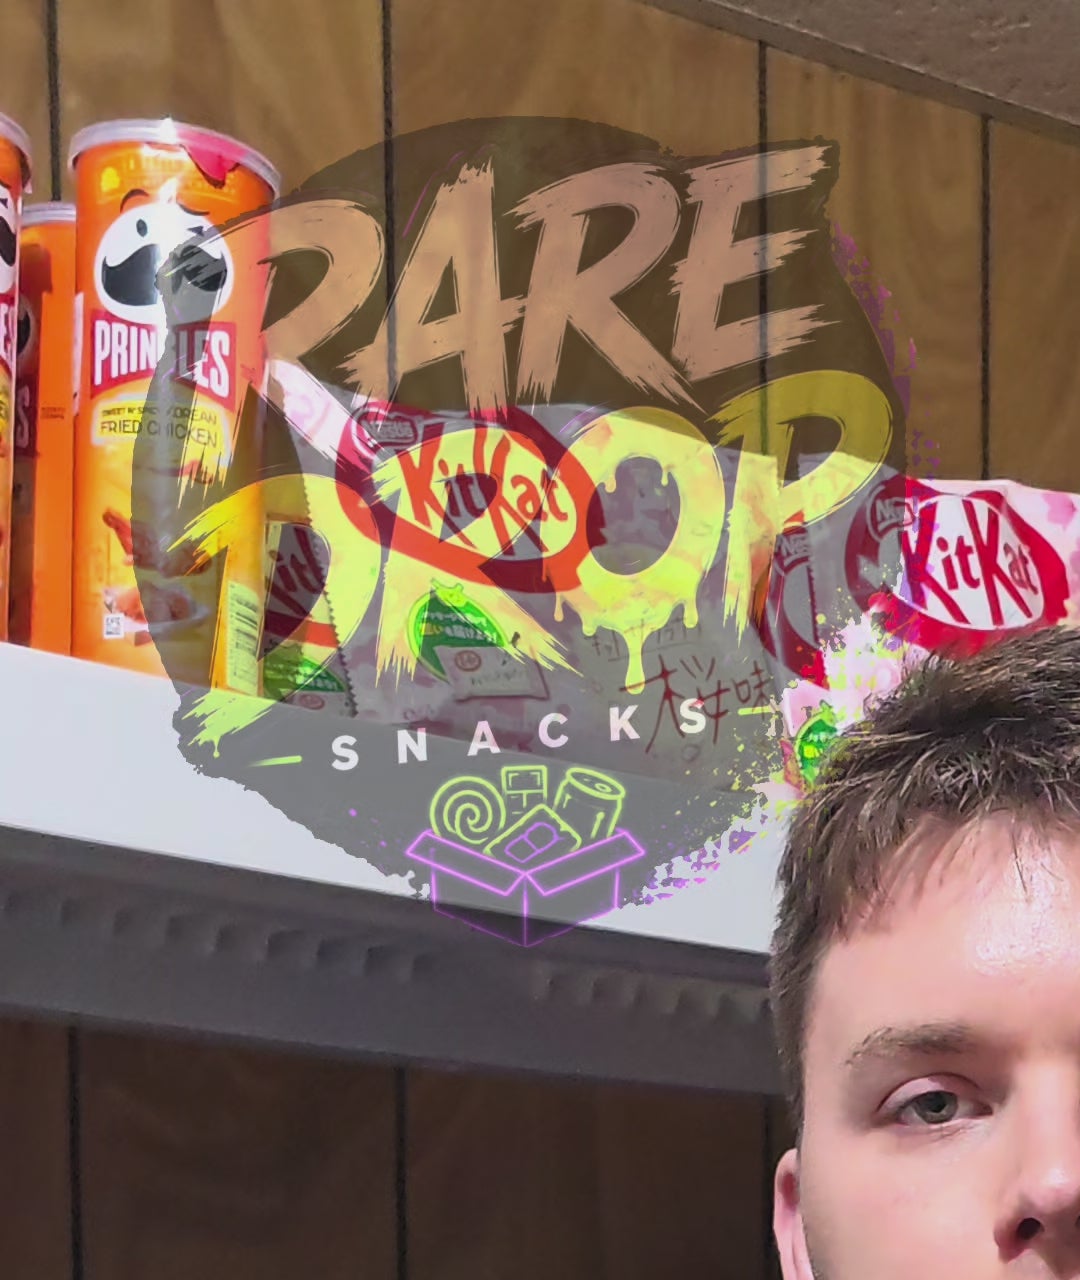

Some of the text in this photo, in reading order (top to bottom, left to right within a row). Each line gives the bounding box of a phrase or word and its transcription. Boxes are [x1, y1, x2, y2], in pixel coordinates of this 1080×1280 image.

[93, 319, 230, 399] PRINLES
[100, 419, 142, 434] FRIED
[394, 420, 569, 557] KitKat
[901, 499, 1040, 627] KitKat
